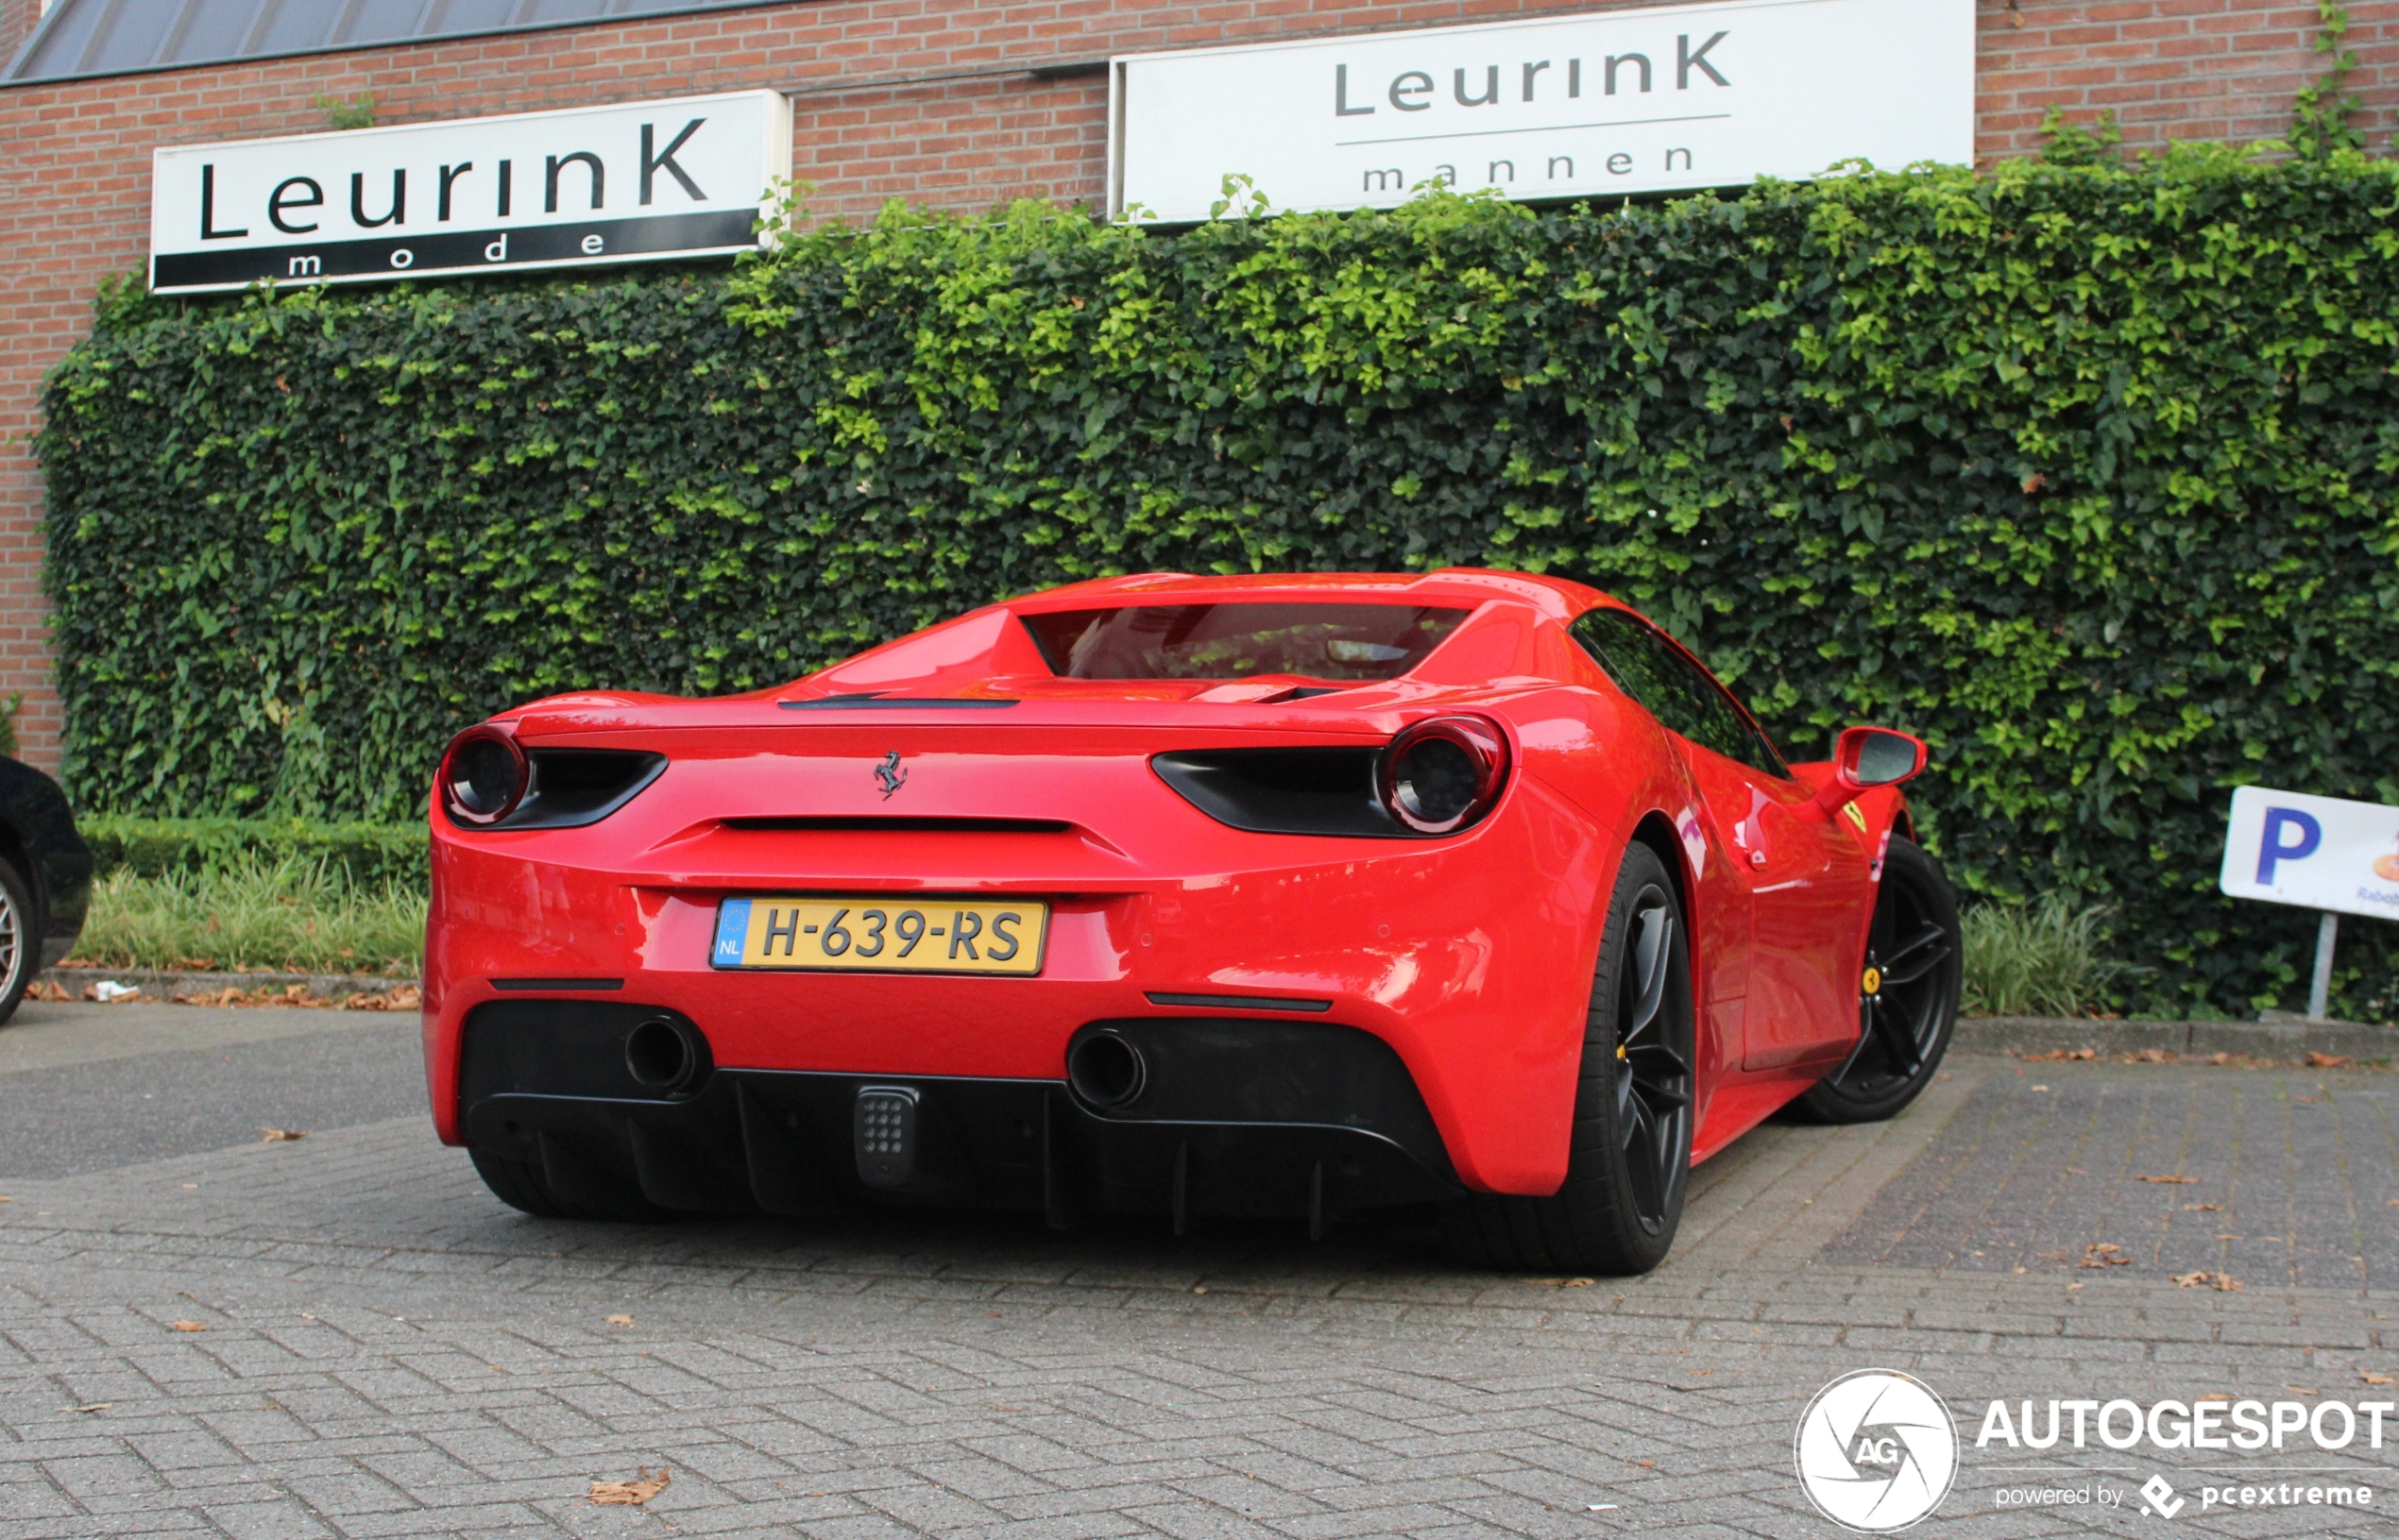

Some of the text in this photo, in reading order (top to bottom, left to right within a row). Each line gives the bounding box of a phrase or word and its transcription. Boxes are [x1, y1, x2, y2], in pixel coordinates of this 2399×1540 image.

[1364, 147, 1693, 191] mannen
[289, 234, 604, 276] mode
[2256, 806, 2322, 885] P
[720, 939, 740, 956] NL
[763, 908, 1021, 961] H-639-RS
